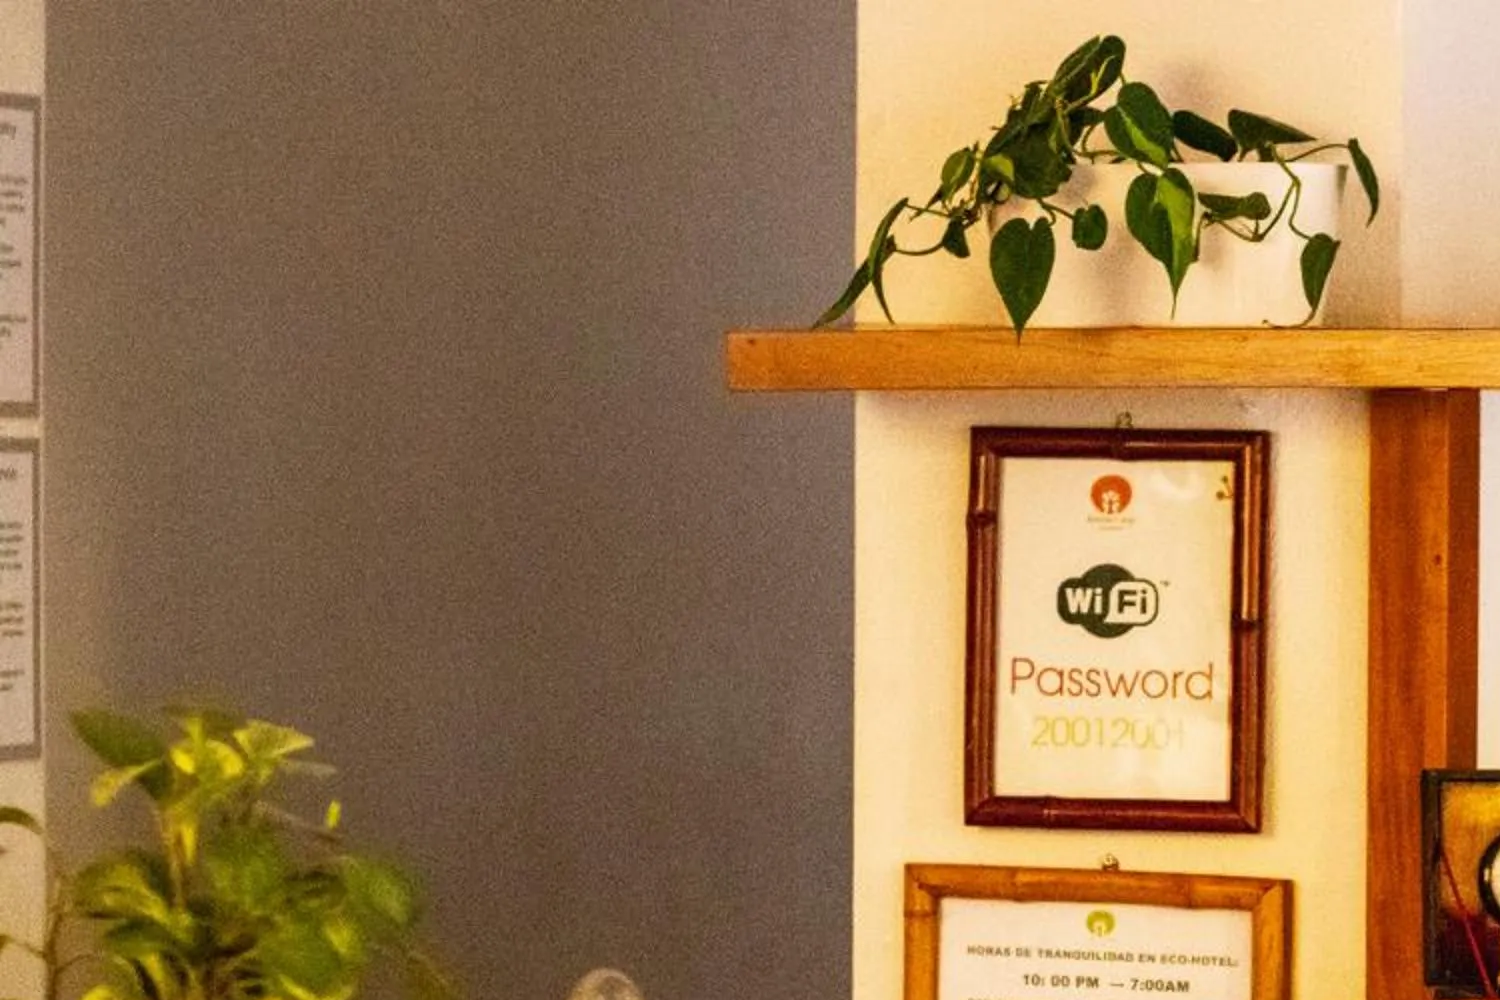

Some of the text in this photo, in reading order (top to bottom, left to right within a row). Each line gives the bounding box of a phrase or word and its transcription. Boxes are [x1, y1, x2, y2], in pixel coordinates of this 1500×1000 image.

[1064, 588, 1148, 615] WiFi
[1010, 657, 1214, 700] Password
[967, 945, 1011, 957] HORAS
[1015, 947, 1032, 958] DE
[1037, 948, 1134, 963] TRANQUILIDAD
[1138, 953, 1156, 964] EN
[1051, 975, 1071, 988] 00
[1075, 976, 1100, 989] PM
[1130, 978, 1191, 993] 7:00AM
